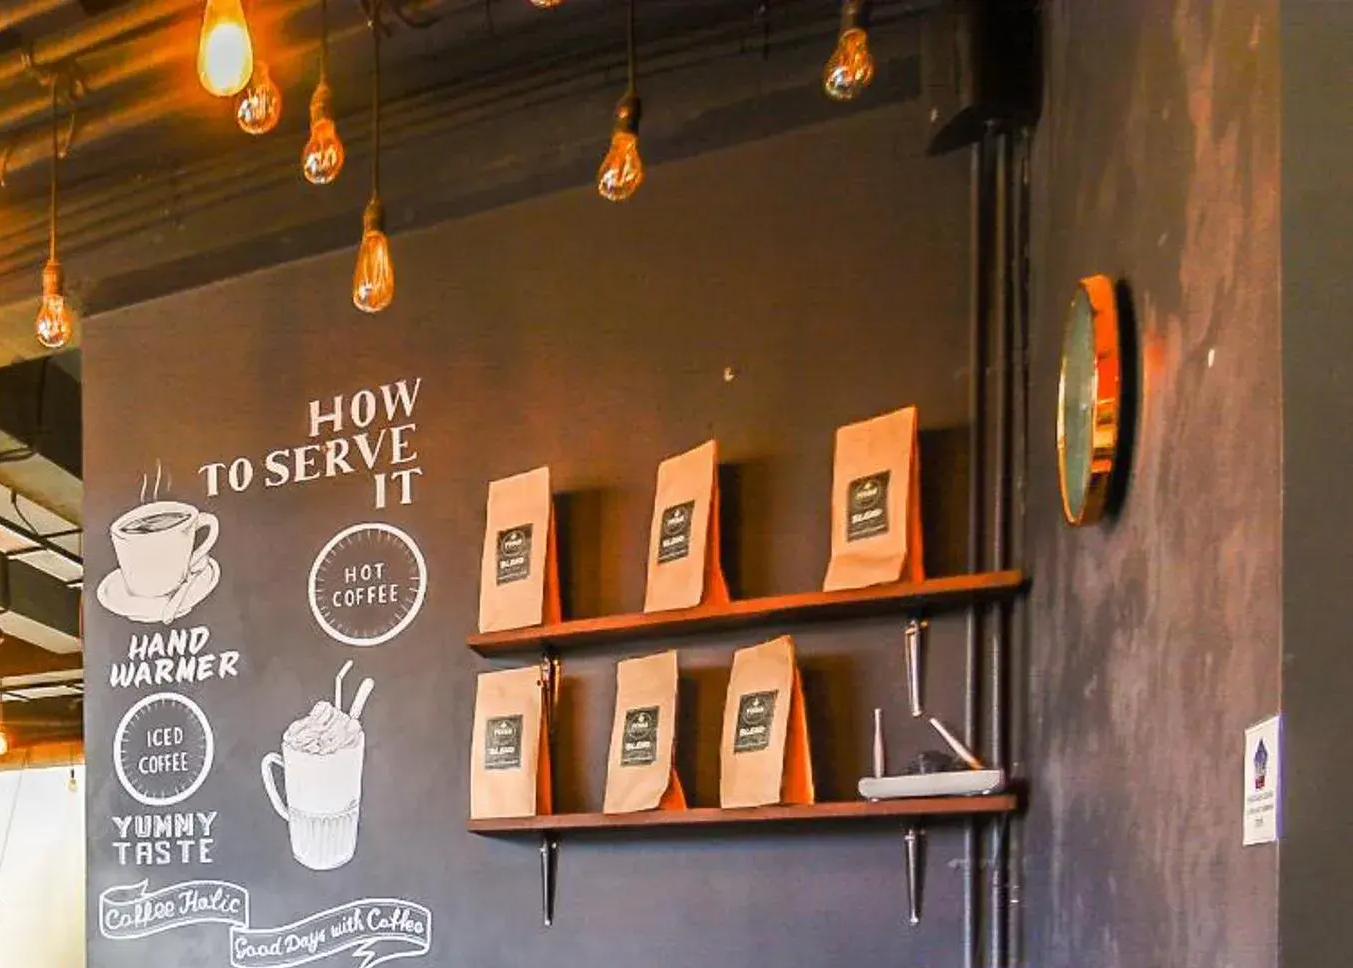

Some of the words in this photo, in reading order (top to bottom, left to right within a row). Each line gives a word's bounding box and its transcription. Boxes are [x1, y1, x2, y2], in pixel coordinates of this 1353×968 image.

[308, 378, 423, 437] HOW
[198, 457, 254, 498] TO
[264, 423, 418, 488] SERVE
[373, 467, 424, 509] IT
[344, 563, 386, 583] HOT
[332, 584, 399, 608] COFFEE
[128, 626, 210, 661] HAND
[109, 651, 240, 688] WARMER
[147, 727, 184, 748] ICED
[138, 752, 189, 775] COFFEE
[112, 811, 217, 839] YUMMY
[112, 838, 214, 865] TASTE
[105, 901, 175, 930] Coffee
[234, 938, 282, 960] Good
[284, 927, 326, 955] Days
[330, 909, 364, 939] with
[366, 906, 424, 934] Coffee
